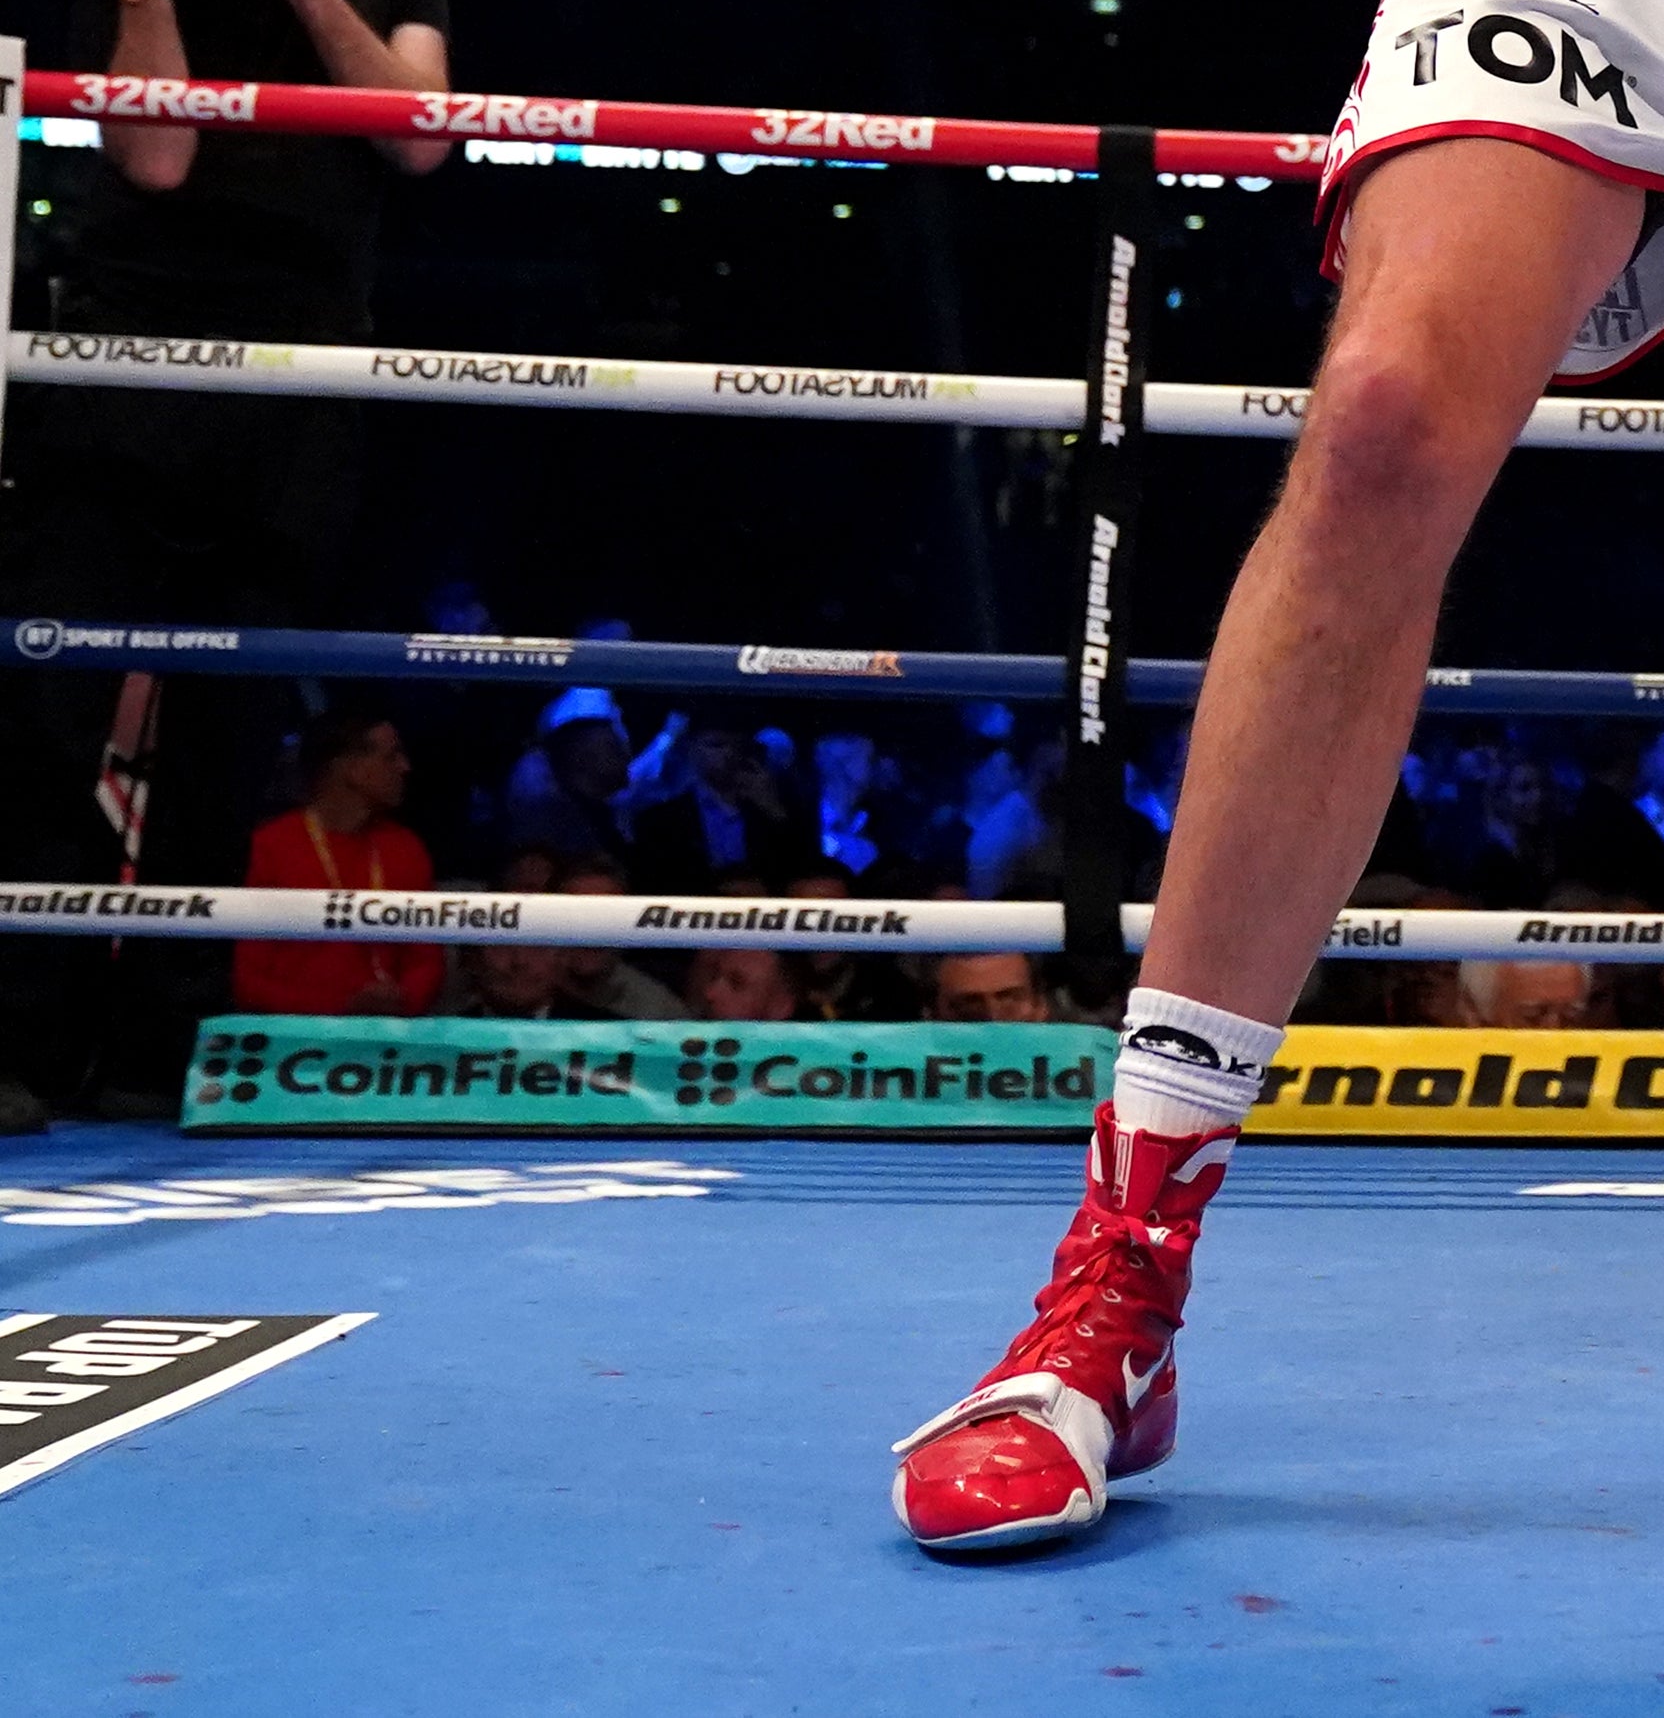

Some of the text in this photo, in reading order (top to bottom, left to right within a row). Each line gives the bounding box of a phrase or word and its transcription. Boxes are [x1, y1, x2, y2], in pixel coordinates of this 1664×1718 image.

[1395, 9, 1638, 129] TOM
[71, 74, 256, 122] 32Red
[412, 92, 597, 139] 32Red
[751, 109, 935, 150] 32Red
[97, 891, 216, 918] Clark
[358, 899, 519, 930] CoinField
[636, 904, 910, 935] Arnold Clark
[1516, 919, 1663, 945] Arnold
[276, 1045, 634, 1096] CoinField
[750, 1050, 1095, 1103] CoinField
[16, 1319, 261, 1378] TOP
